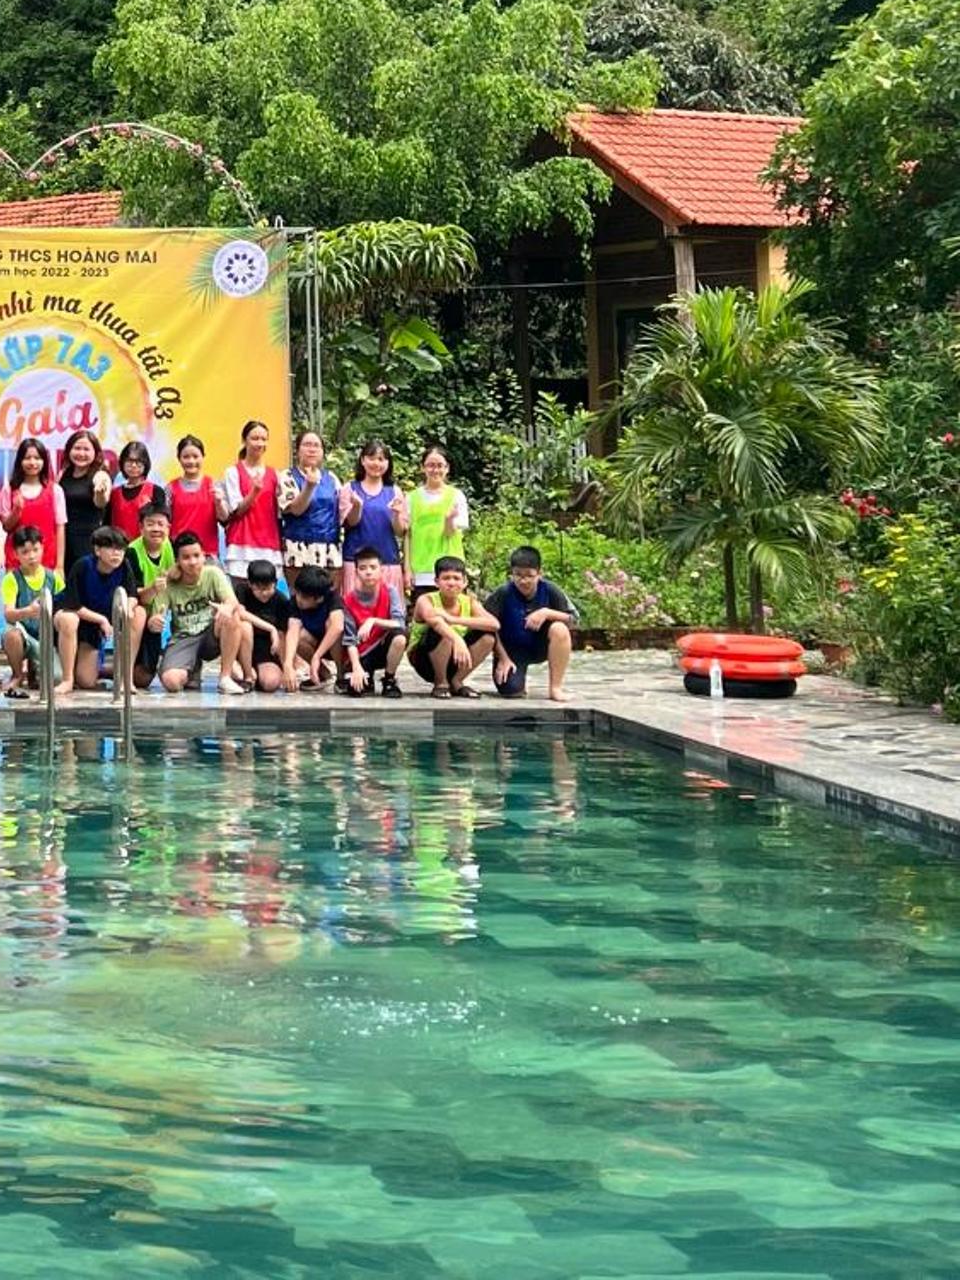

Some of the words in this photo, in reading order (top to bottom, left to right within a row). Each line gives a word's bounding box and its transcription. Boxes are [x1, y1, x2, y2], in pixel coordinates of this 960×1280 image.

[9, 248, 51, 263] THCS
[57, 247, 120, 264] HOÀNG
[126, 250, 157, 264] MAI
[14, 266, 37, 278] học
[41, 267, 70, 278] 2022
[80, 267, 109, 278] 2023
[43, 294, 82, 315] ma
[88, 300, 140, 346] thua
[56, 333, 112, 382] 7A3
